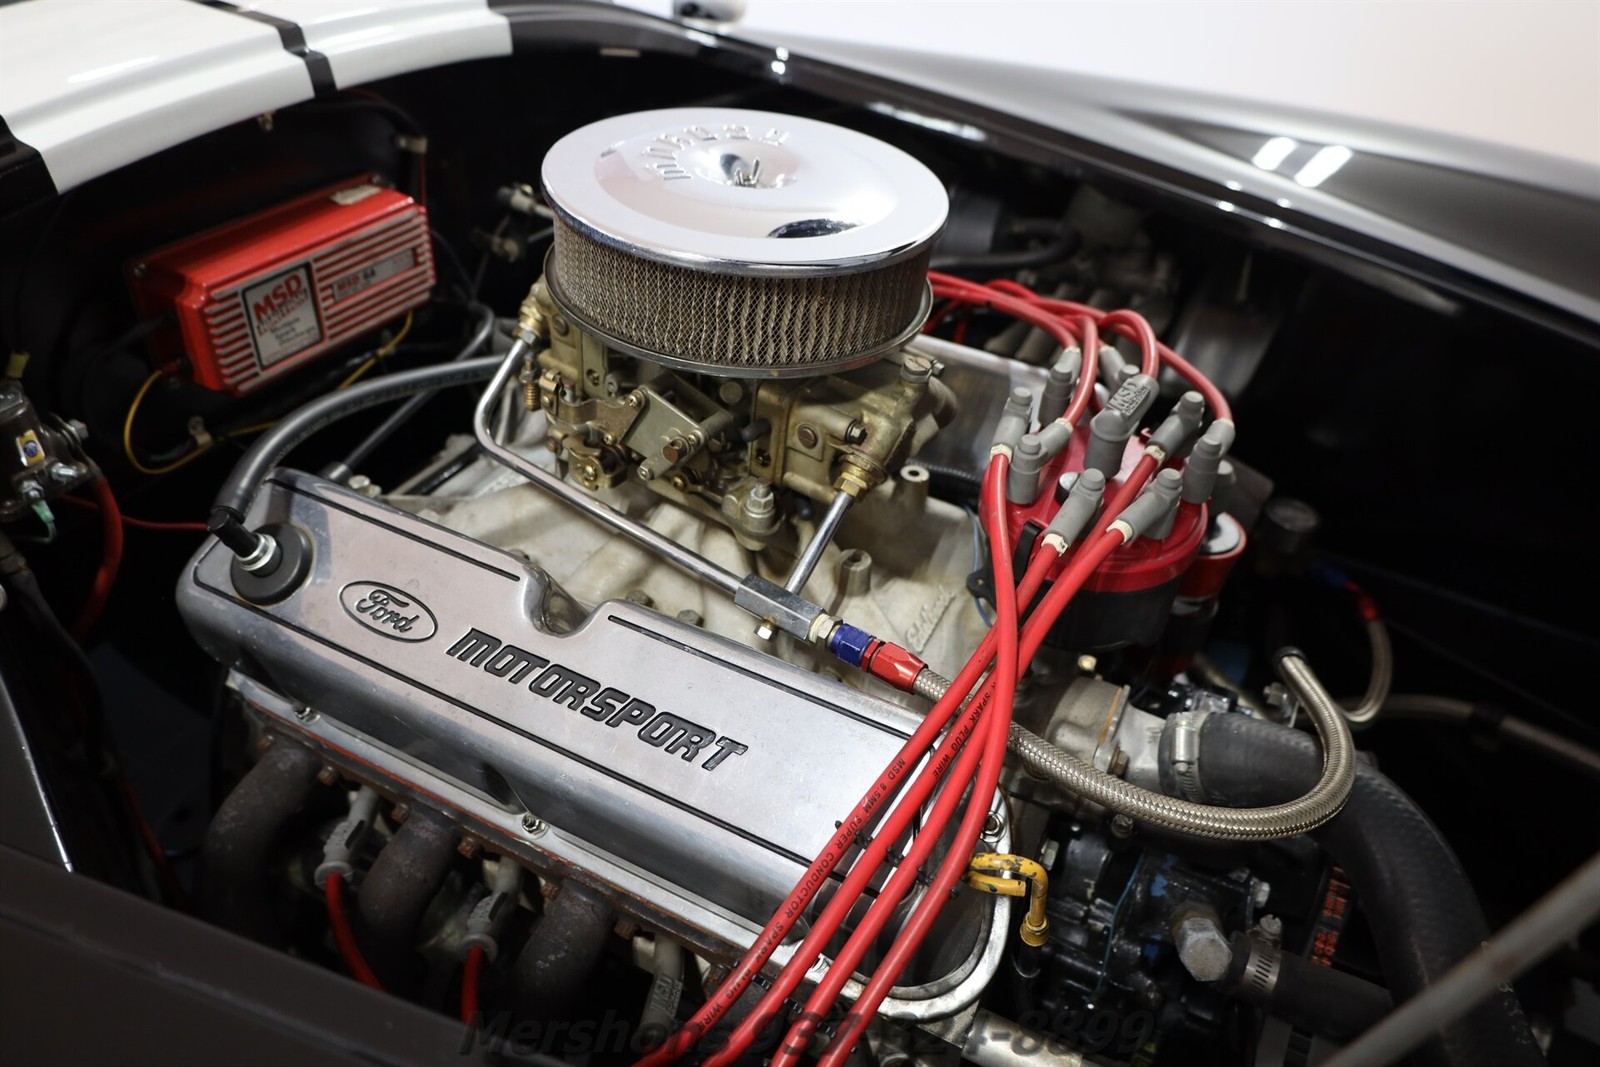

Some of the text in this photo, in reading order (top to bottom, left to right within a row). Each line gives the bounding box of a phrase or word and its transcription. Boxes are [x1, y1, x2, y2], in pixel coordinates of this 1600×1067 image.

[253, 273, 302, 324] MSD
[1107, 382, 1138, 411] MSD
[355, 589, 420, 634] Ford
[445, 626, 749, 772] MOTORSPORT
[932, 692, 991, 781] SPARK PLUG WIRE
[887, 758, 906, 781] MSD
[863, 782, 888, 815] 8.5MM
[835, 815, 863, 849] SUPER
[787, 852, 835, 919] CONDUCTOR
[756, 921, 785, 964] SPARK
[698, 1002, 724, 1033] WIRE
